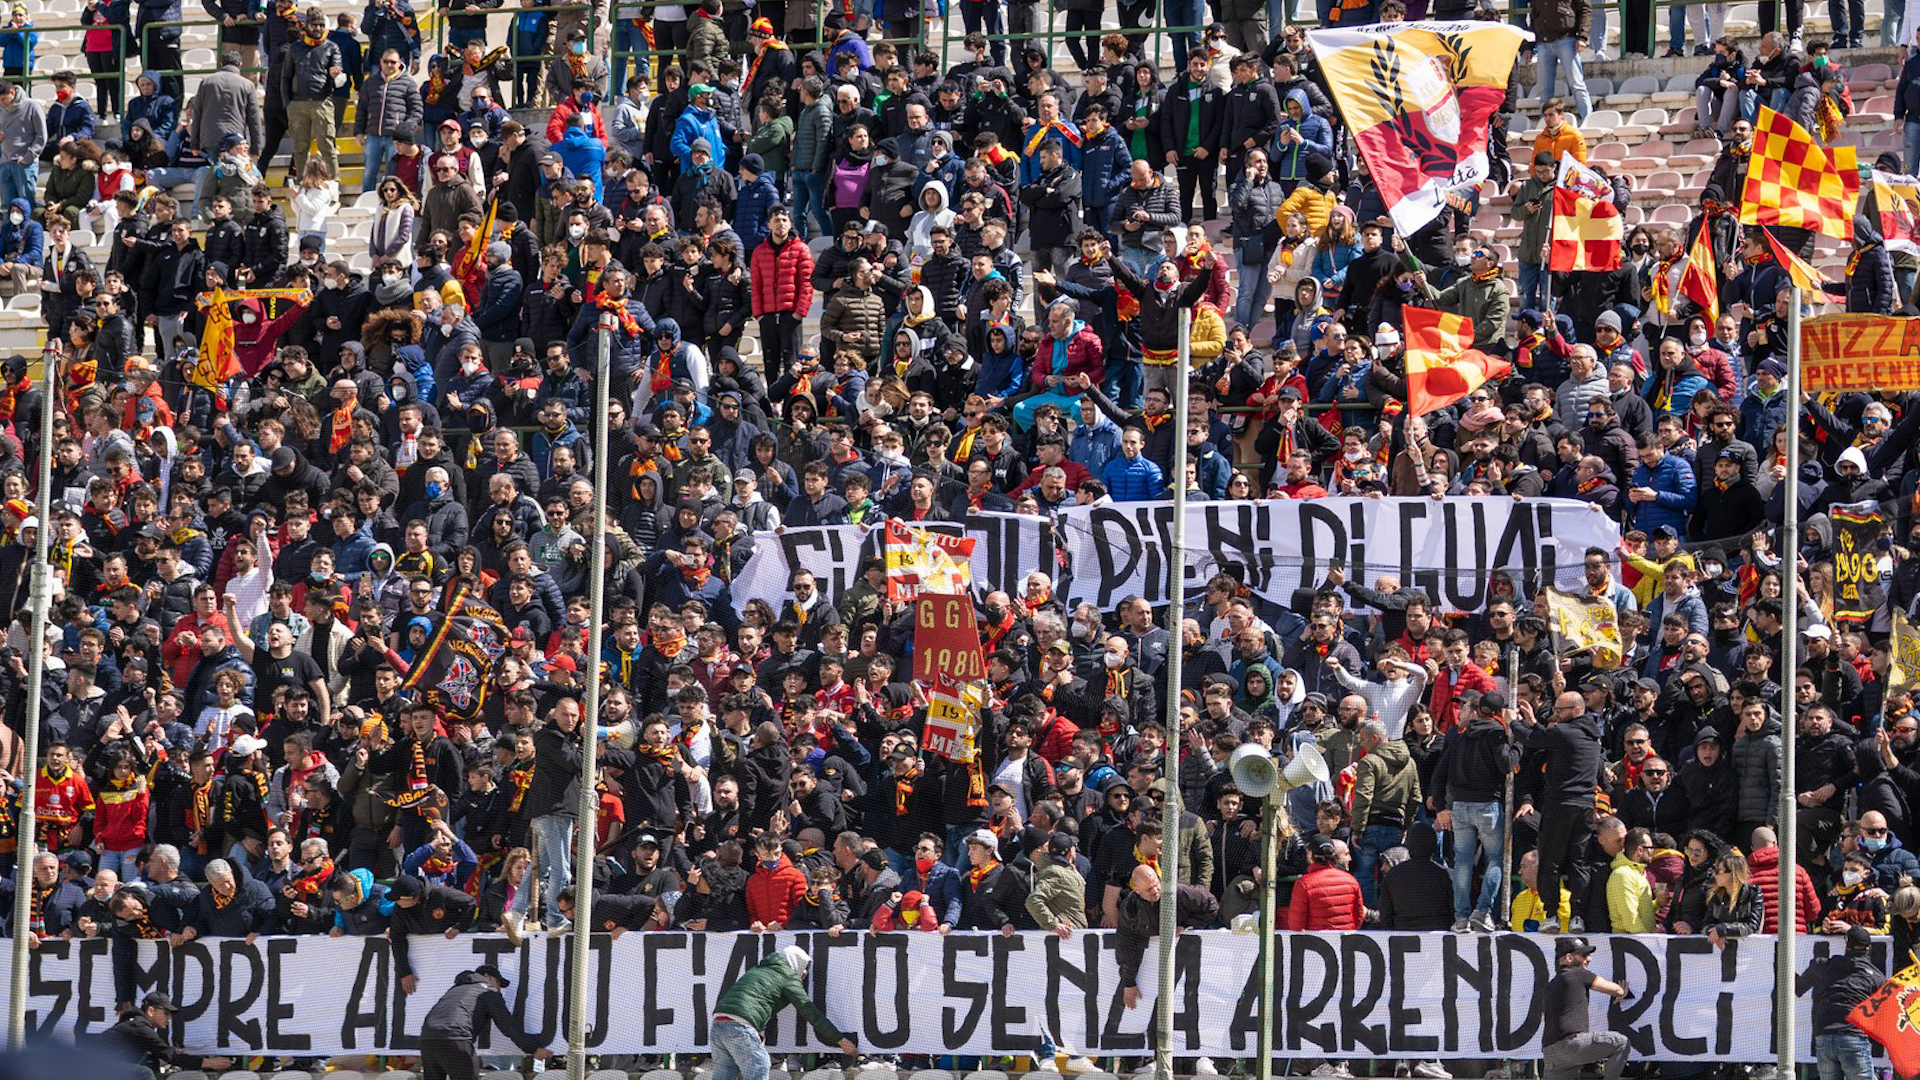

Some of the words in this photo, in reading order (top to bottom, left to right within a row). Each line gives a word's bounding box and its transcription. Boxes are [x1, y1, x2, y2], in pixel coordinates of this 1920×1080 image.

[1801, 319, 1920, 361] NIZZA
[1806, 361, 1920, 391] PRESENT
[924, 647, 980, 677] 1980
[24, 938, 312, 1051] SEMPRE
[340, 936, 424, 1050] AL
[472, 936, 612, 1050] TUO
[941, 934, 1203, 1051] SENZA
[1229, 934, 1738, 1056] ARRENDRCi
